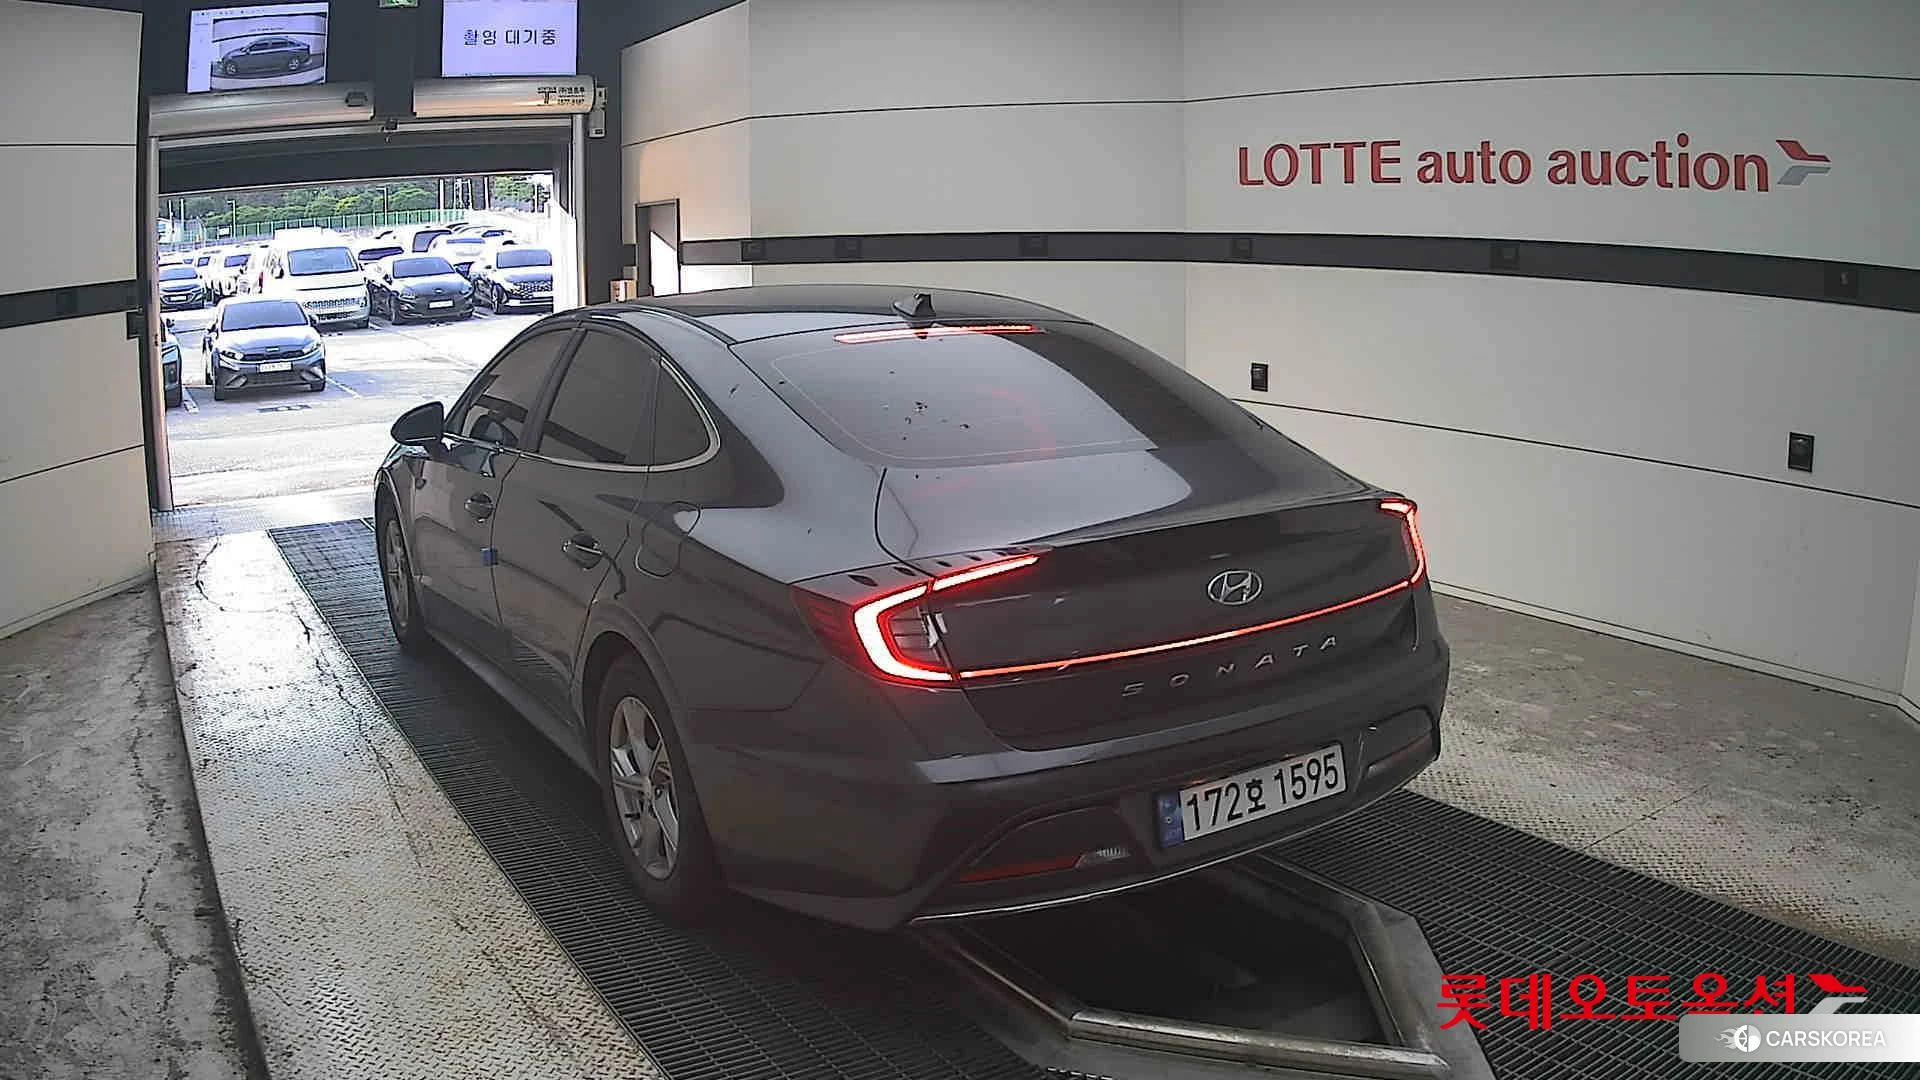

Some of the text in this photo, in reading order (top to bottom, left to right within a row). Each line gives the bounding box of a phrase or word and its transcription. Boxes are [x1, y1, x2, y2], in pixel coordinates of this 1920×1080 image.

[505, 29, 557, 46] 대기중
[1238, 132, 1770, 193] LOTTE auto auction
[1121, 635, 1338, 697] SONATA
[1186, 752, 1339, 832] 172호 1595
